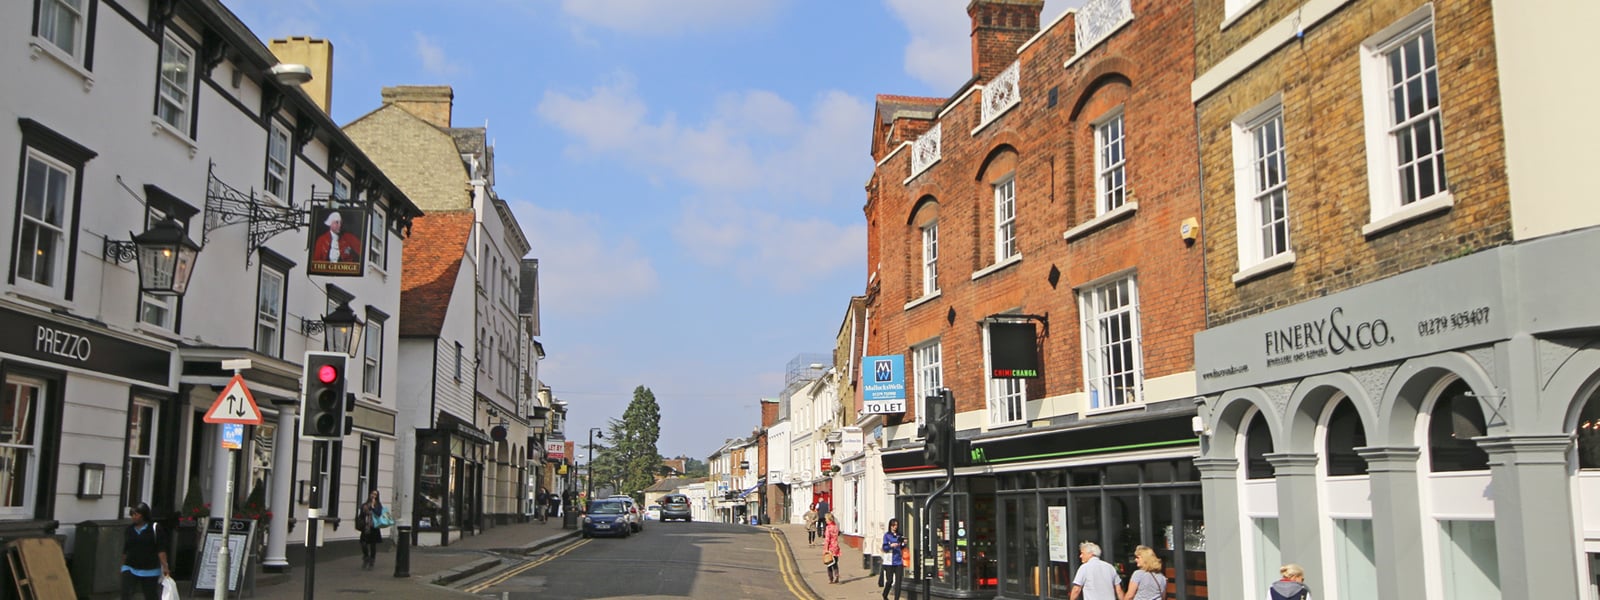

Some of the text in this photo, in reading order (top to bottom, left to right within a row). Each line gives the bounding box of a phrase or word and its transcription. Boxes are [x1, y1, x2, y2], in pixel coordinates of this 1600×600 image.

[35, 325, 91, 361] PREZZO
[1265, 318, 1326, 356] FINERY
[993, 369, 1038, 377] CHIMICHANGA
[867, 403, 902, 413] TO LET
